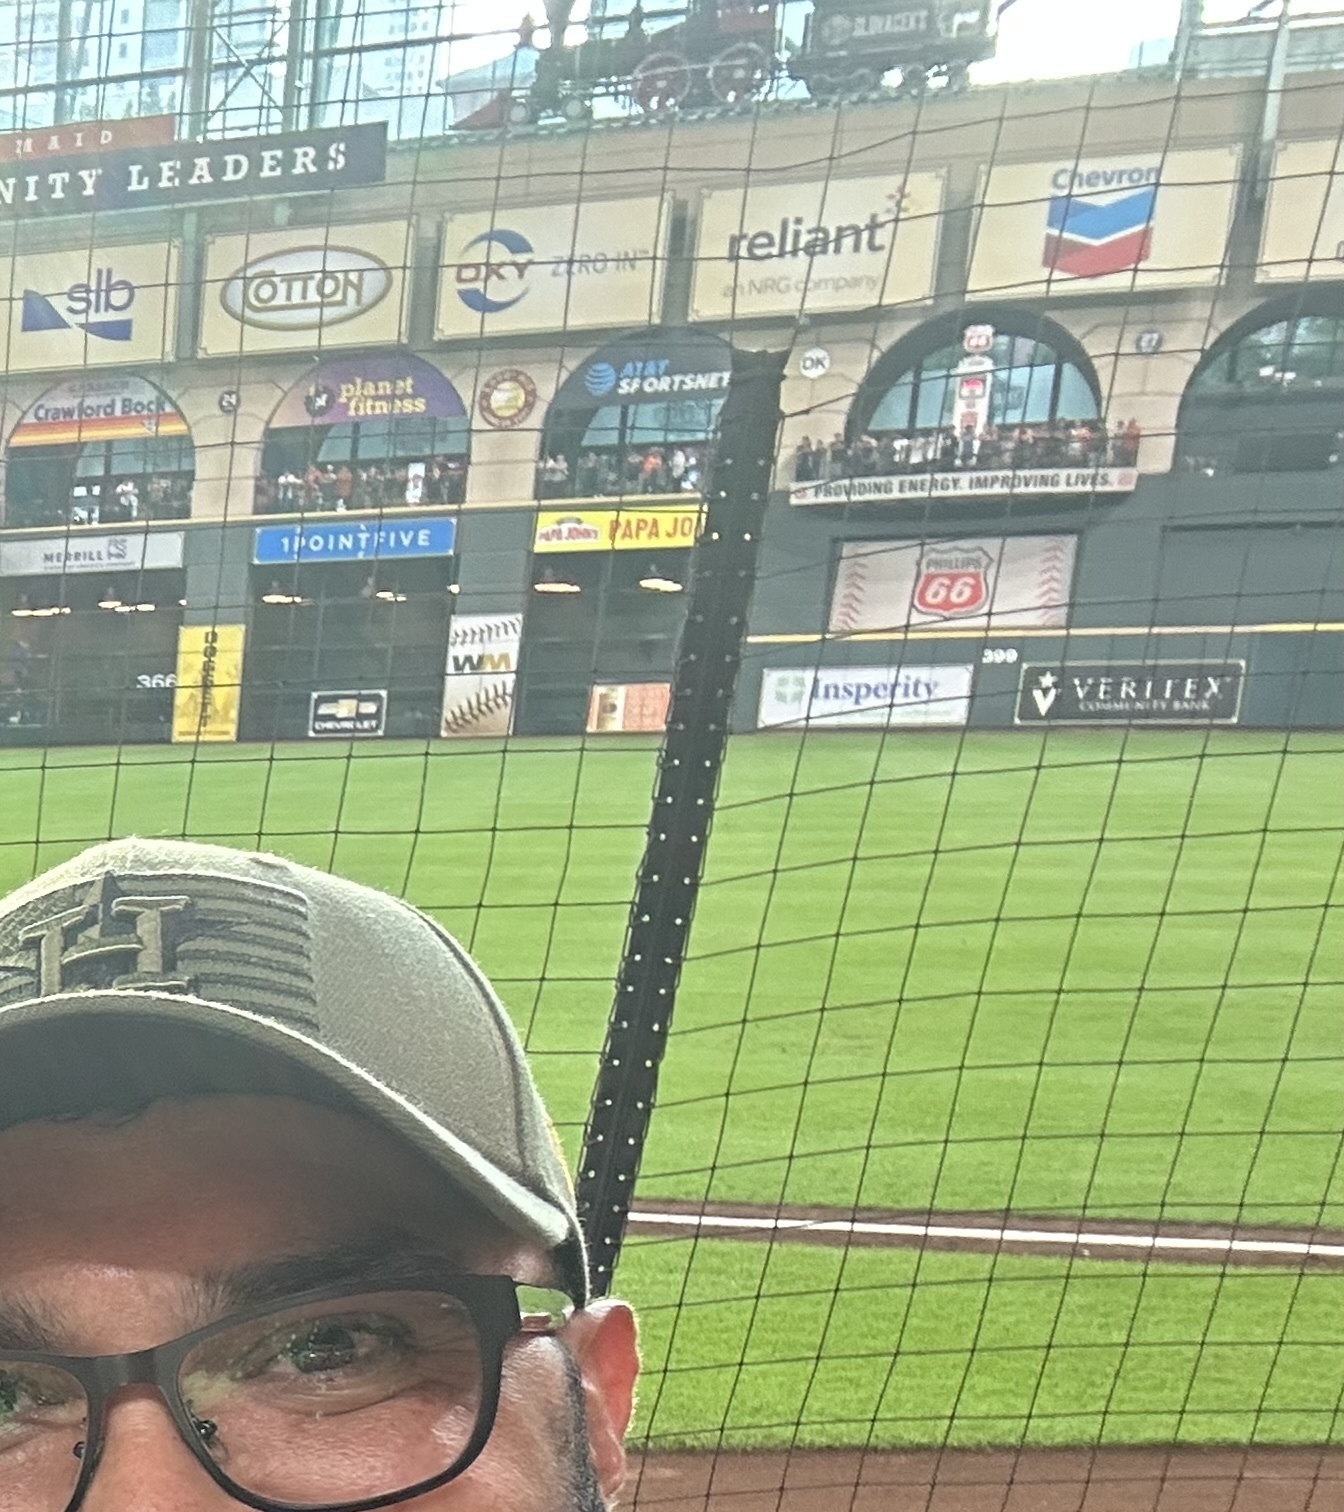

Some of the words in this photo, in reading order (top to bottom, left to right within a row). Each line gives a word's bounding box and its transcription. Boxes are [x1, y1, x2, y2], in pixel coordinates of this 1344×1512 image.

[15, 129, 113, 158] MAID
[128, 142, 347, 192] LEADERS
[1051, 165, 1160, 191] Chevron
[728, 212, 886, 262] reliant
[455, 259, 534, 284] OXY
[550, 253, 609, 278] ZERO
[66, 268, 136, 315] slb
[247, 270, 365, 310] COTTON
[748, 275, 792, 295] NRG
[617, 372, 731, 395] SPORTSNET
[33, 401, 115, 422] Crawford
[815, 482, 893, 498] PROVIDING
[968, 473, 1061, 491] IMPROVING
[280, 529, 432, 555] 1POINTFIVE
[609, 518, 660, 541] PAPA
[43, 552, 103, 563] MERRILL
[925, 576, 976, 604] 66
[452, 652, 513, 672] WM
[812, 675, 940, 706] Insperity
[1073, 676, 1222, 701] VERITEX
[1079, 700, 1168, 712] COMMUNITY
[1173, 699, 1209, 710] BANK
